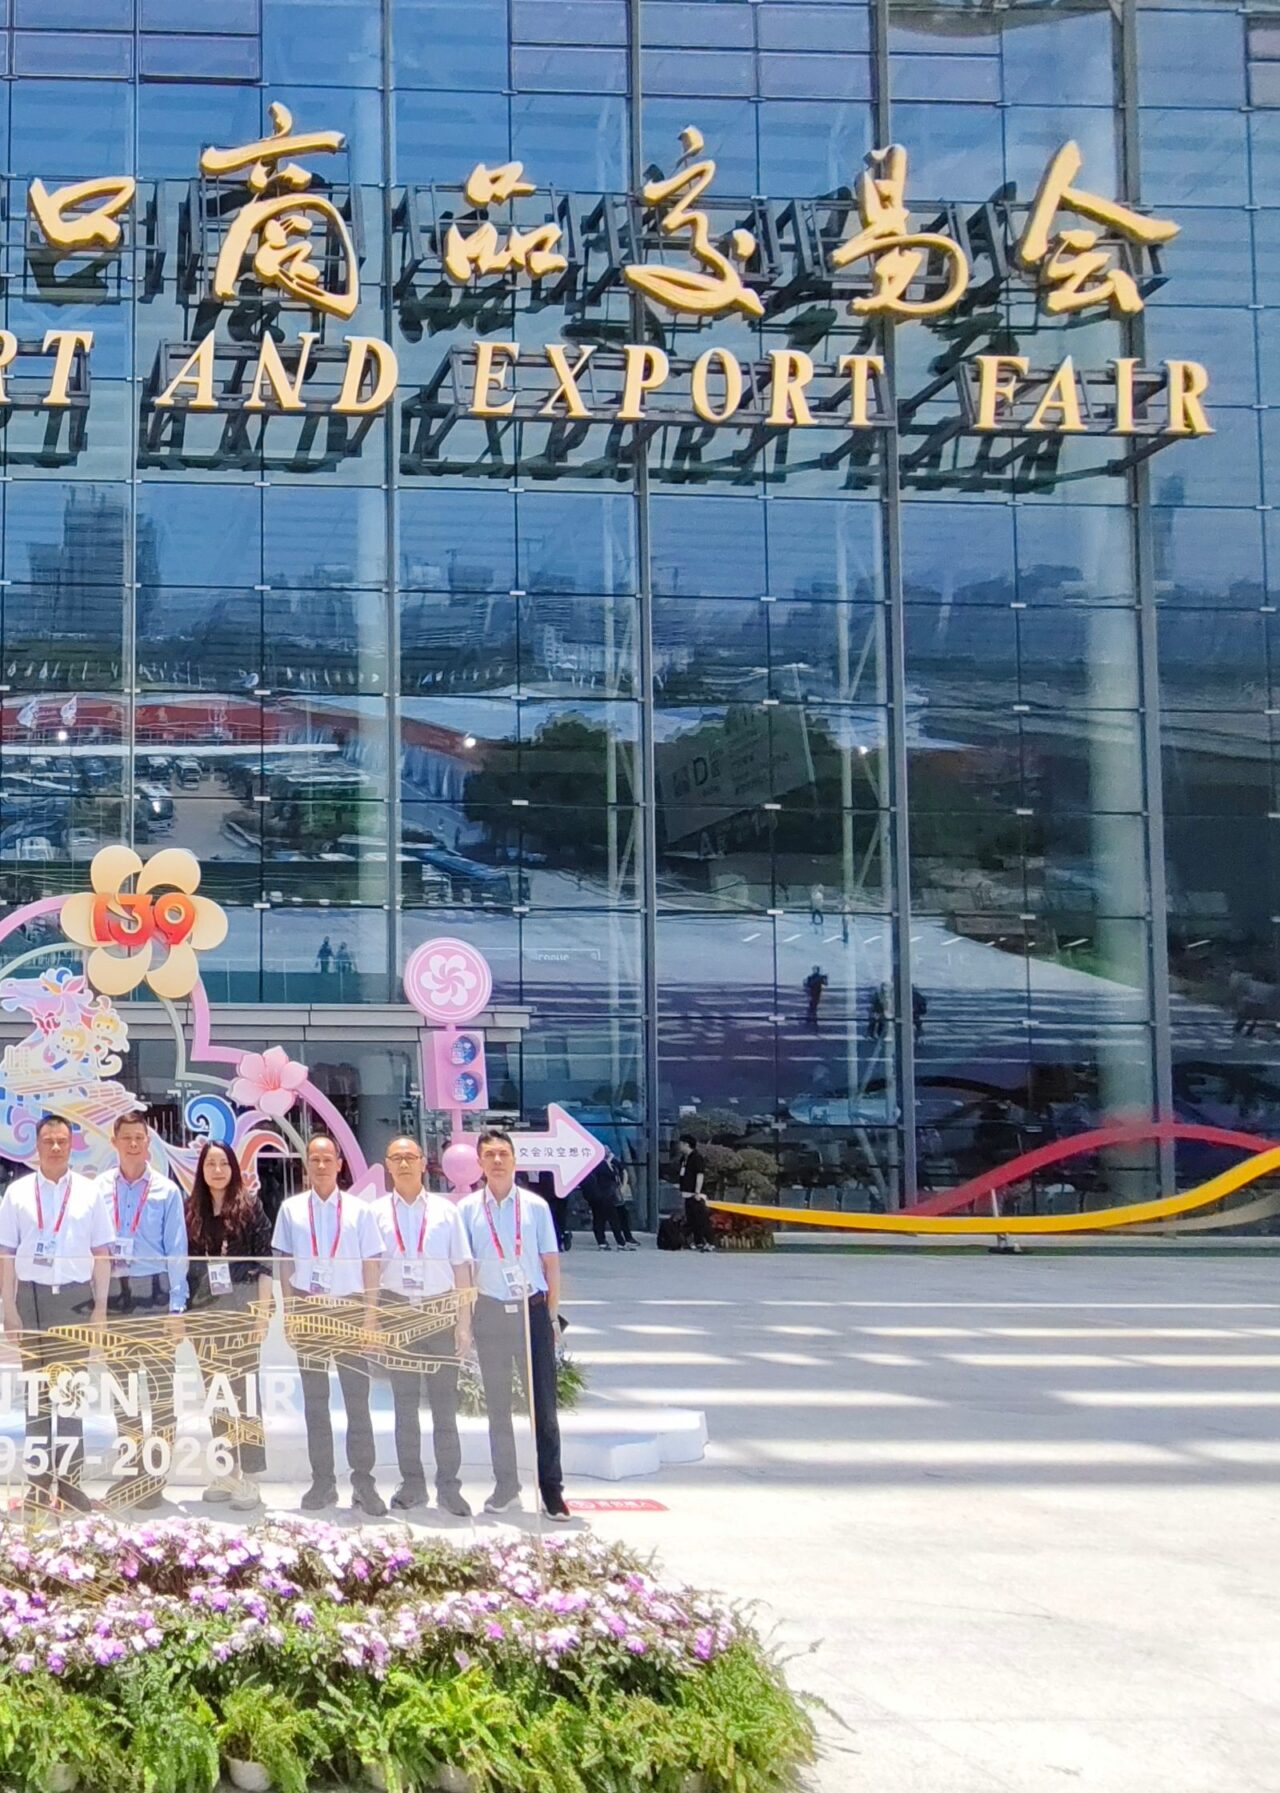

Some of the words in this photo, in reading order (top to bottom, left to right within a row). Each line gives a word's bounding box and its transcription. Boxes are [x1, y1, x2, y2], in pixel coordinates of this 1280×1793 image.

[154, 329, 400, 414] AND
[468, 341, 886, 427] EXPORT
[972, 355, 1216, 436] FAIR
[90, 891, 198, 947] 139
[172, 1371, 297, 1418] FAIR
